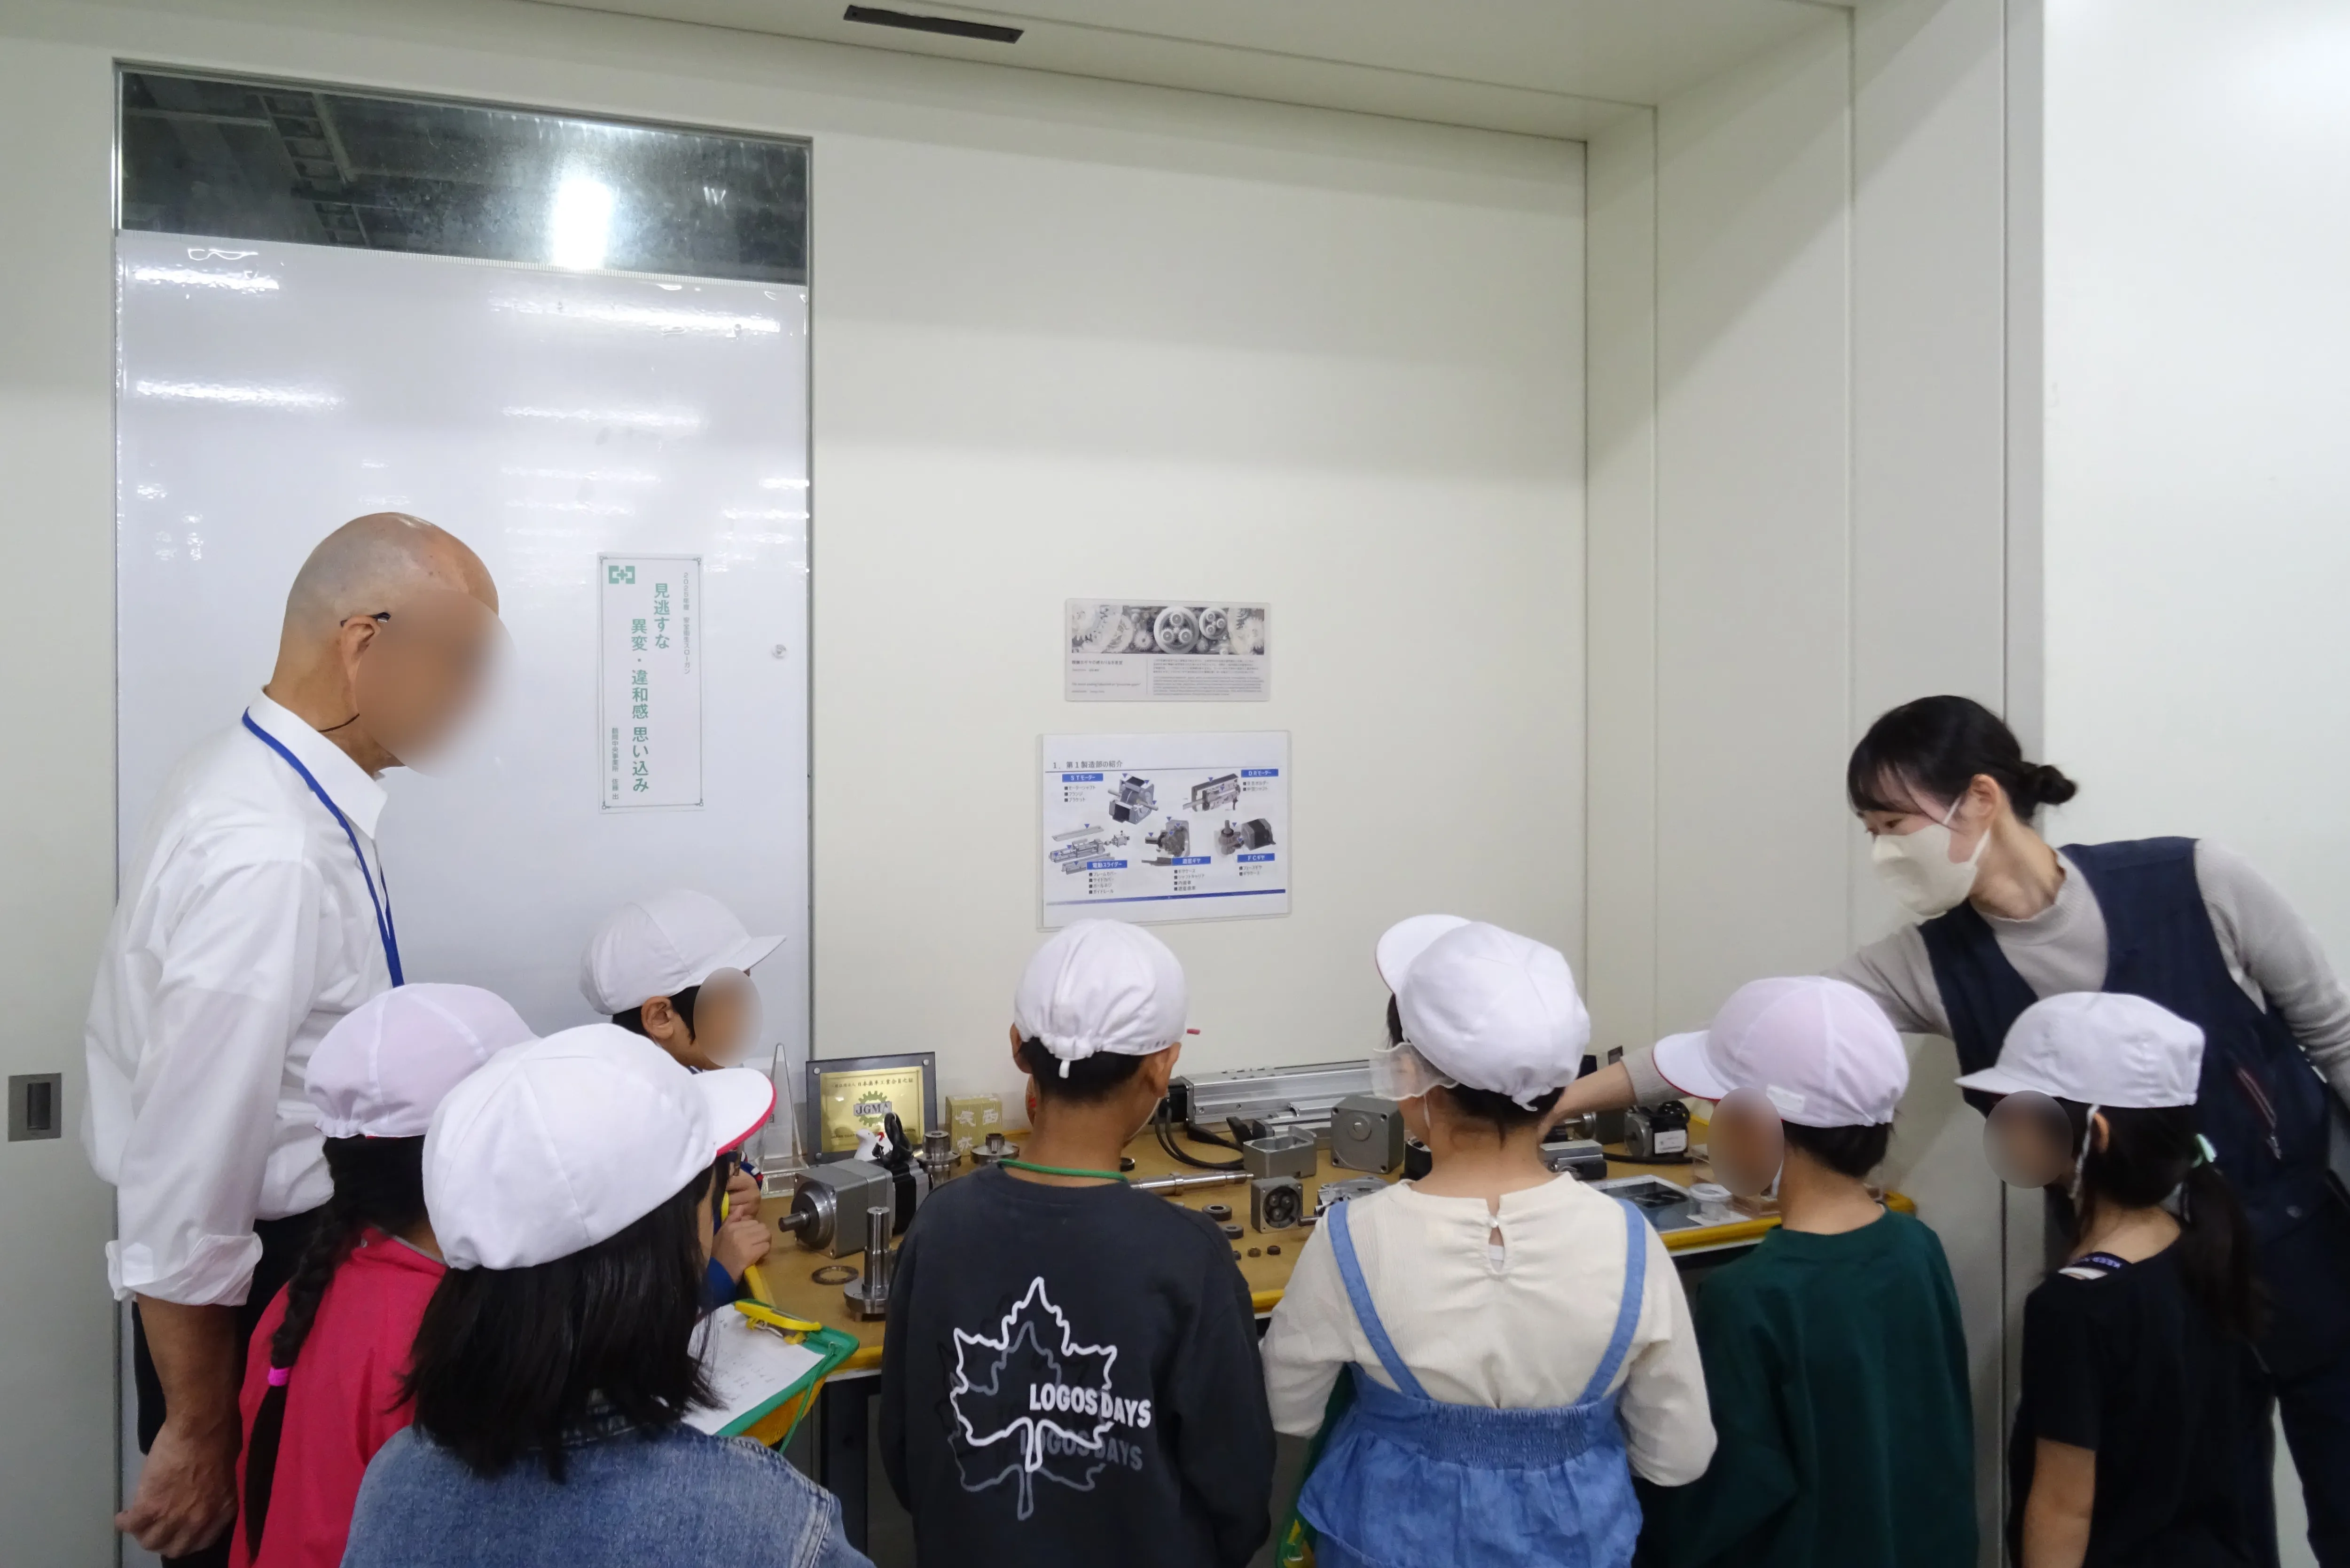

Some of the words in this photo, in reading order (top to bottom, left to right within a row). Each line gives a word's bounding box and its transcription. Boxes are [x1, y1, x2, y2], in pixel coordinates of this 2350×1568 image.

[654, 583, 670, 649] 見逃すな
[631, 619, 648, 719] 異変・違和感
[632, 727, 649, 792] 思い込み
[1066, 760, 1123, 769] 第1製造部の紹介
[1029, 1382, 1098, 1415] LOGOS
[1101, 1390, 1151, 1428] DAYS
